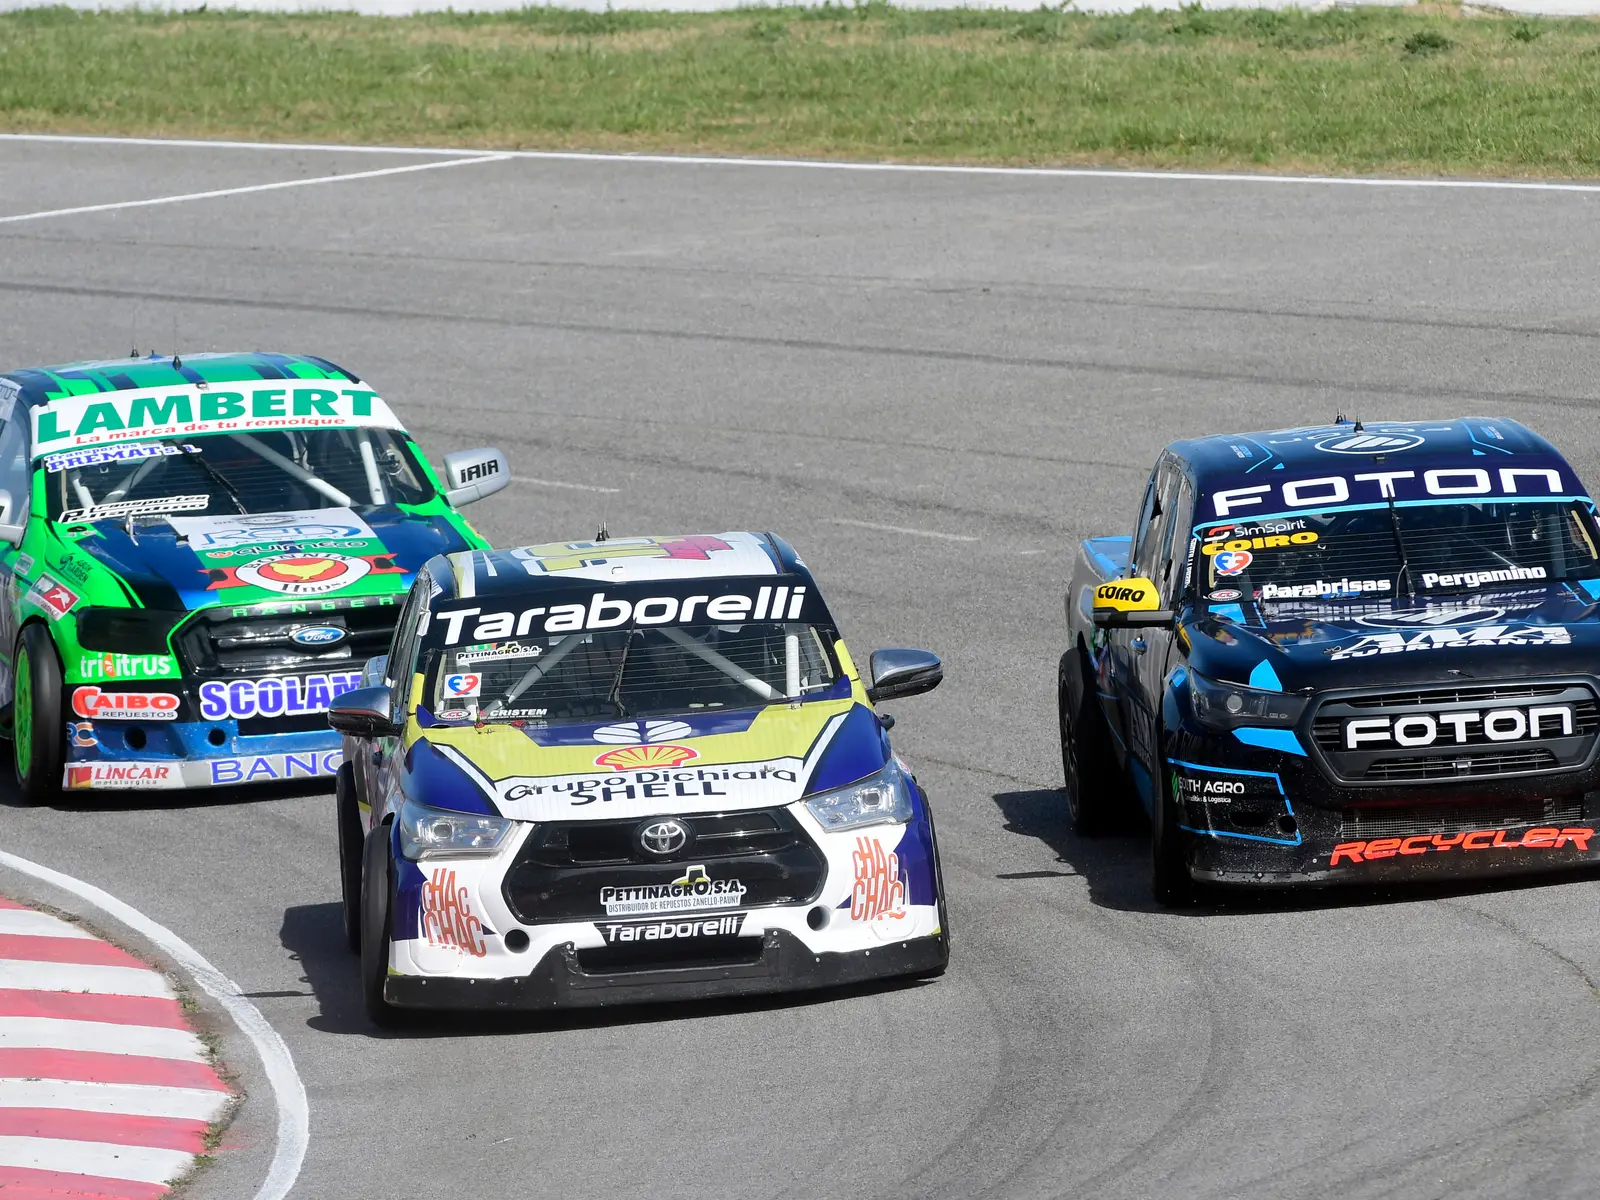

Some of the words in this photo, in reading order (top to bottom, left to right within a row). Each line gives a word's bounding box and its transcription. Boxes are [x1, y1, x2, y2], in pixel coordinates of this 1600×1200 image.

[38, 389, 378, 444] LAMBERT
[76, 437, 100, 445] La
[109, 426, 176, 440] marca
[184, 423, 209, 432] de
[217, 421, 237, 429] tu
[245, 417, 346, 427] remolque
[50, 446, 160, 472] PREMAT
[1213, 468, 1563, 517] FOTON
[1201, 531, 1319, 555] COIRO
[1262, 578, 1391, 599] Parabrisas
[1422, 566, 1547, 588] Pergamino
[1097, 585, 1146, 603] COIRO
[232, 597, 394, 617] RANGER
[436, 586, 806, 645] Taraborelli
[303, 630, 334, 642] Ford
[1331, 638, 1572, 660] LUBRICANTS
[73, 687, 177, 716] CAIBO
[490, 708, 548, 717] CRISTEM
[1346, 706, 1573, 749] FOTON
[95, 767, 169, 780] LINCAR
[504, 777, 626, 801] Grupo
[636, 768, 797, 784] Dichiara
[570, 781, 727, 806] SHELL
[1203, 780, 1245, 794] AGRO
[602, 881, 709, 903] PETTINAGRO
[714, 880, 745, 894] S.A.
[608, 902, 650, 913] DISTRIBUIDOR
[650, 901, 658, 910] DE
[659, 898, 692, 909] REPUESTOS
[606, 917, 738, 942] Taraborelli
